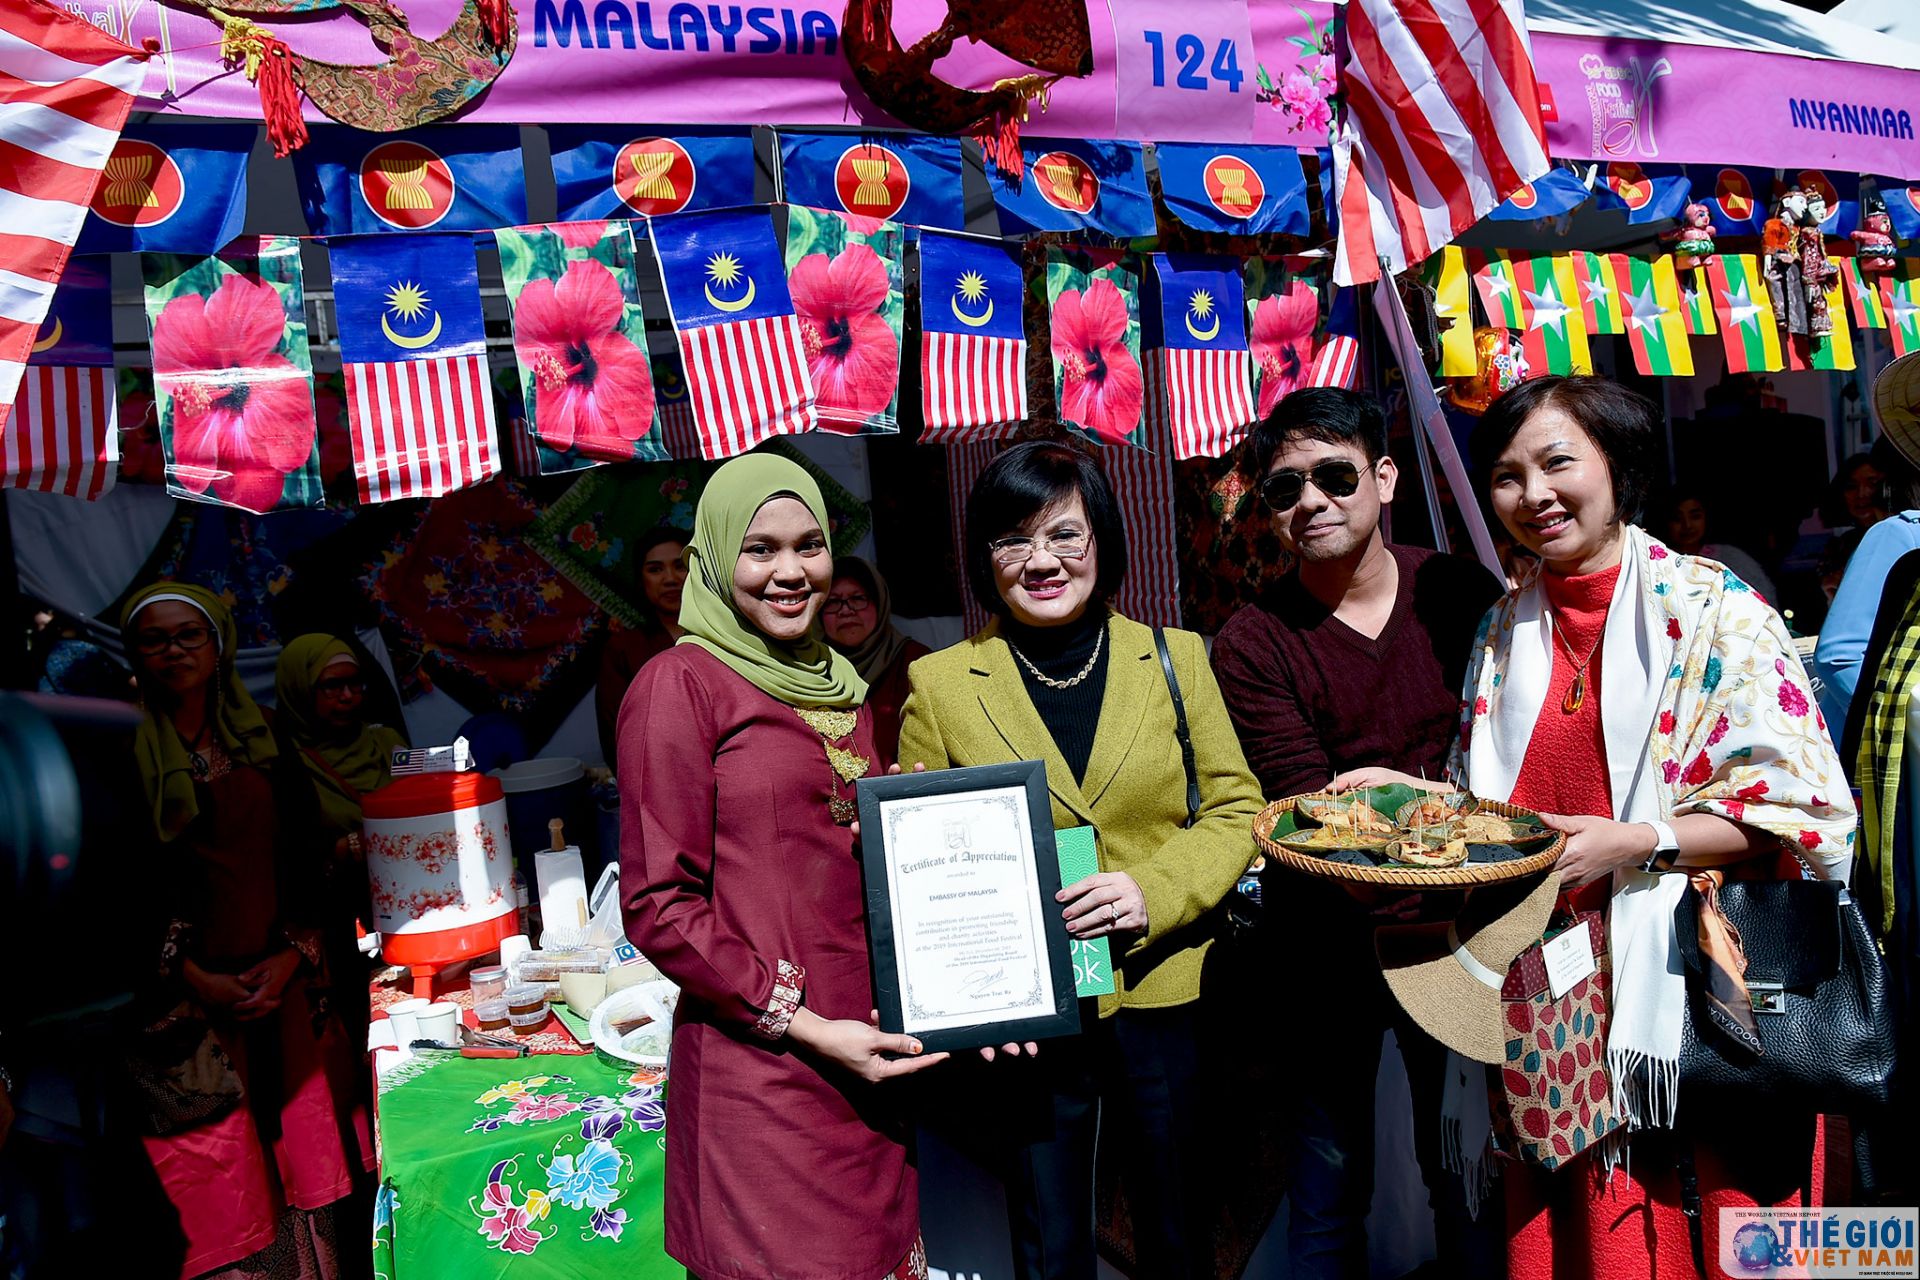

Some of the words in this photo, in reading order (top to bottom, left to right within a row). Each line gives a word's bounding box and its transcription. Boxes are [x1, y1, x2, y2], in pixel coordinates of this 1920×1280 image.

[534, 0, 838, 56] MALAYSIA
[1143, 30, 1244, 93] 124
[1789, 97, 1914, 140] MYANMAR
[900, 856, 946, 874] Certificate
[949, 853, 958, 864] of
[961, 850, 1017, 864] Appreciation
[929, 892, 957, 902] EMBASSY
[967, 887, 998, 898] MALAYSIA
